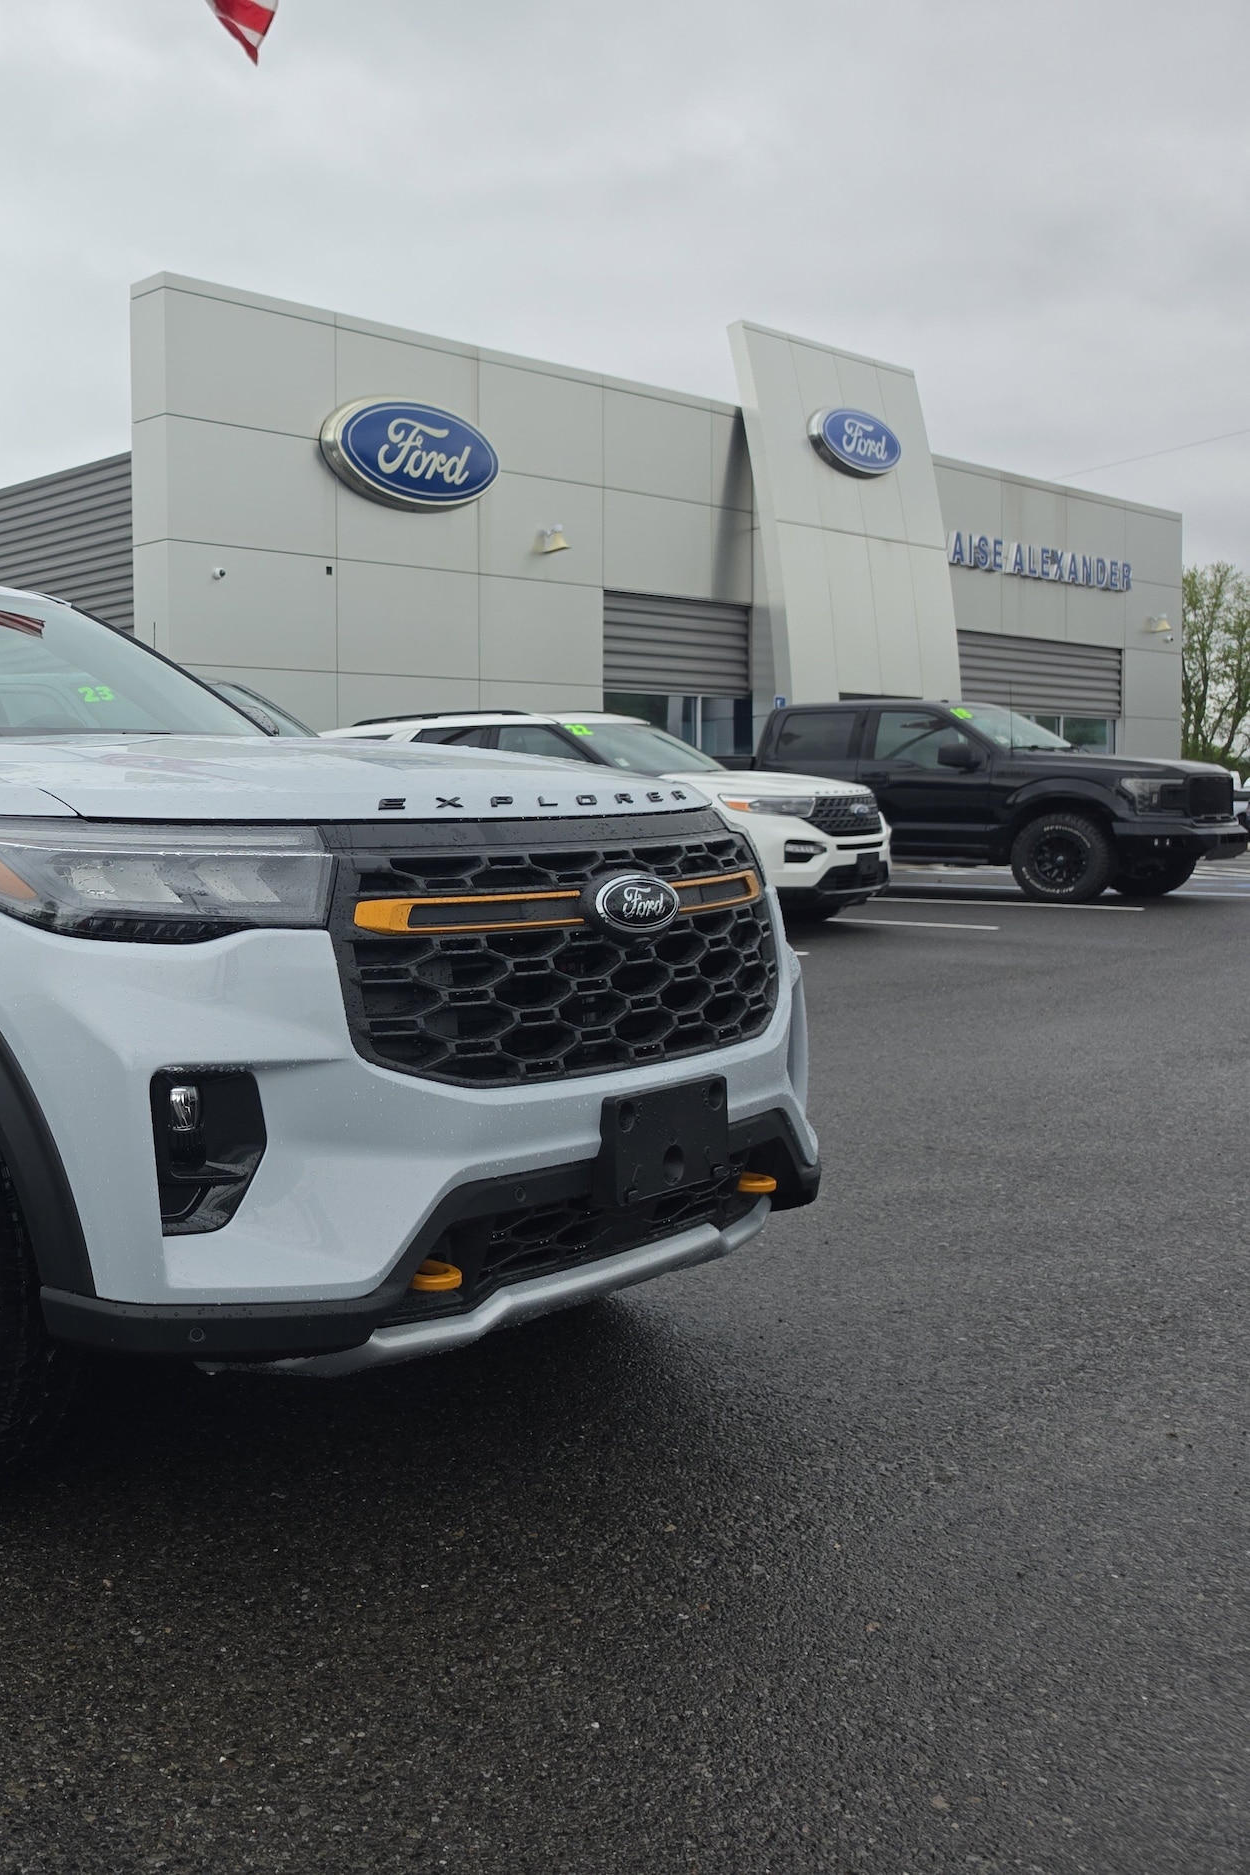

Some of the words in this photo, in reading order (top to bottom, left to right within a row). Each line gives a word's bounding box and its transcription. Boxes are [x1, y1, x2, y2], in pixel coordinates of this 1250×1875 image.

[377, 417, 471, 485] Ford
[842, 418, 888, 461] Ford
[1009, 542, 1132, 592] ALEXANDER
[77, 686, 115, 702] 23
[564, 724, 594, 736] 22
[378, 789, 687, 811] EXPLORER
[622, 886, 666, 919] Ford
